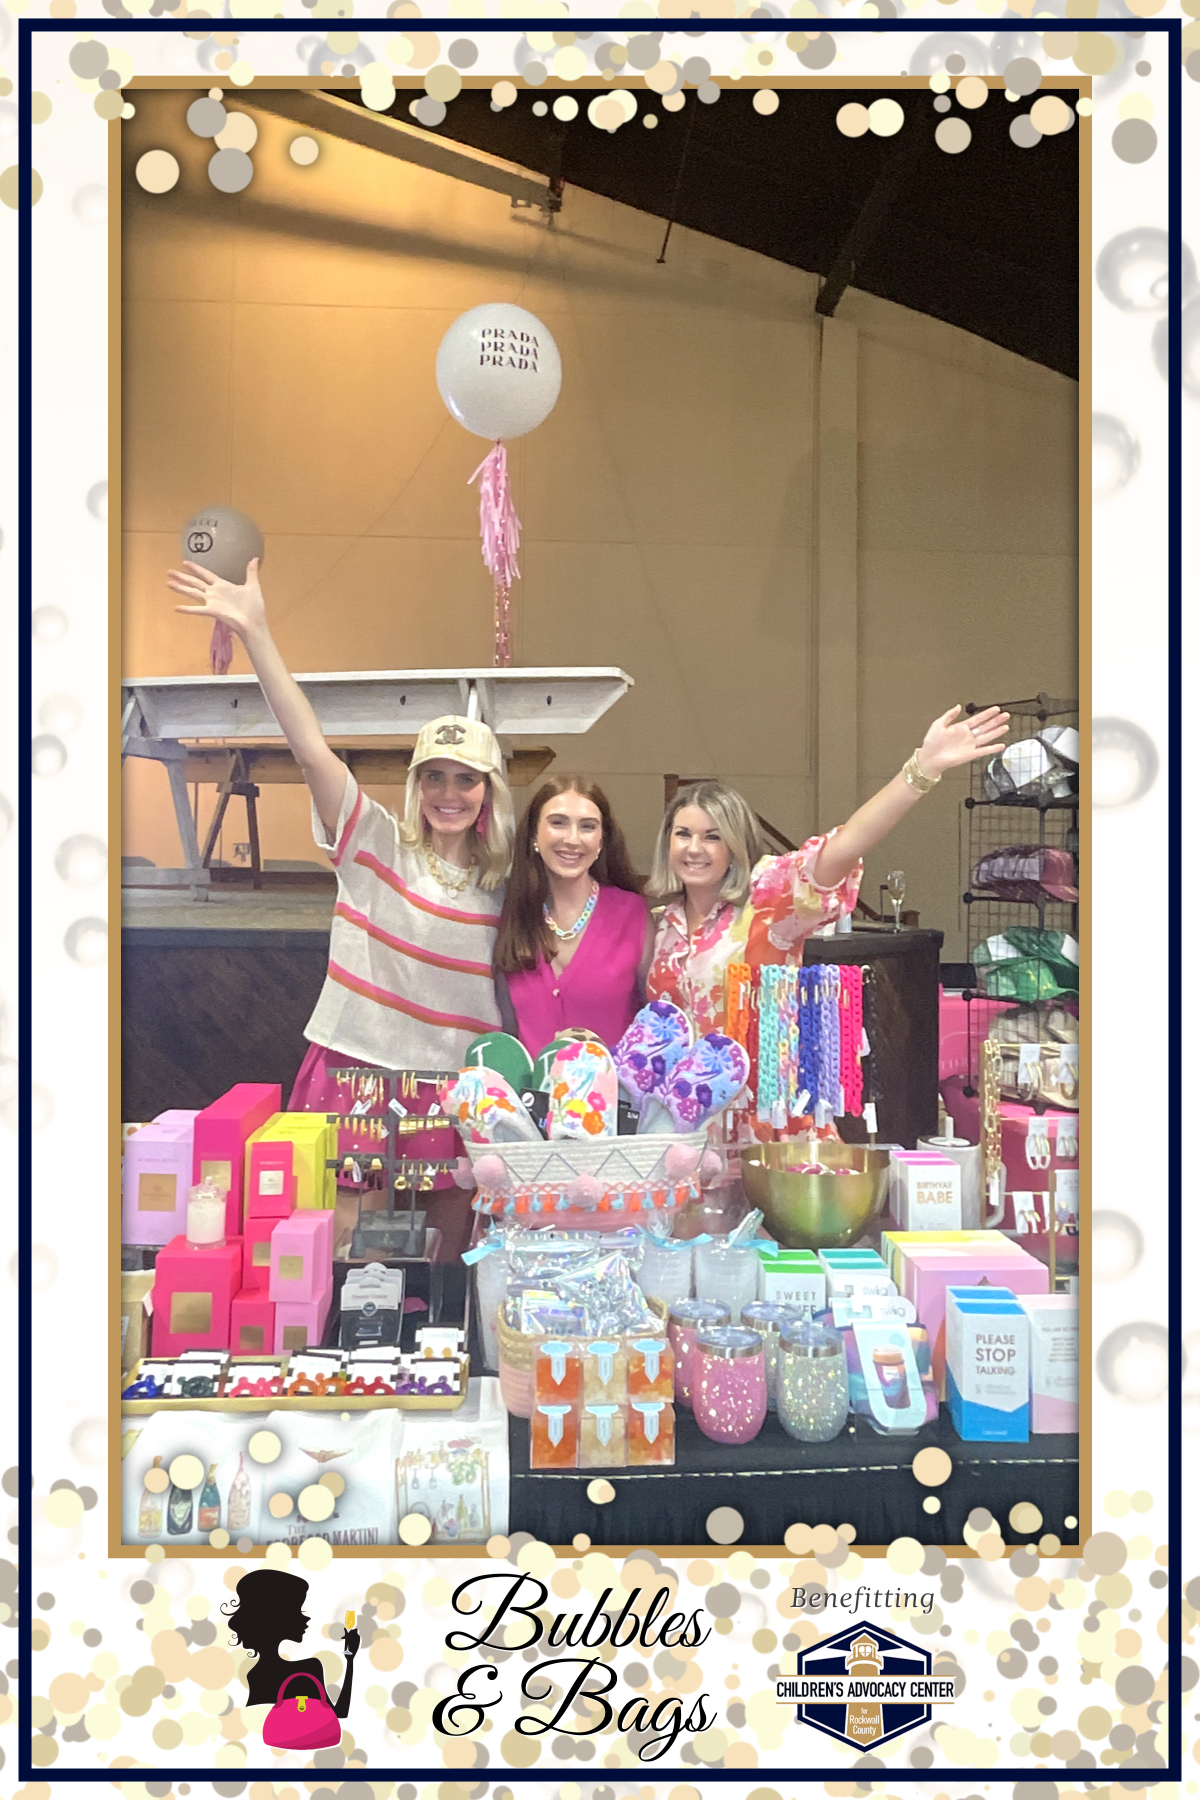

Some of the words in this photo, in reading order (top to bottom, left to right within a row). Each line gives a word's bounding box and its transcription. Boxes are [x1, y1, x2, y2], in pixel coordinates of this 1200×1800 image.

[482, 328, 539, 348] PRADA
[481, 341, 539, 361] PRADA
[479, 354, 538, 374] PRADA
[916, 1181, 953, 1190] BIRTHYAY
[916, 1190, 954, 1204] BABE
[775, 1290, 817, 1301] SWEET
[975, 1333, 1015, 1345] PLEASE
[975, 1348, 1016, 1362] STOP
[975, 1365, 1015, 1376] TALKING
[333, 1526, 379, 1546] MARTINI
